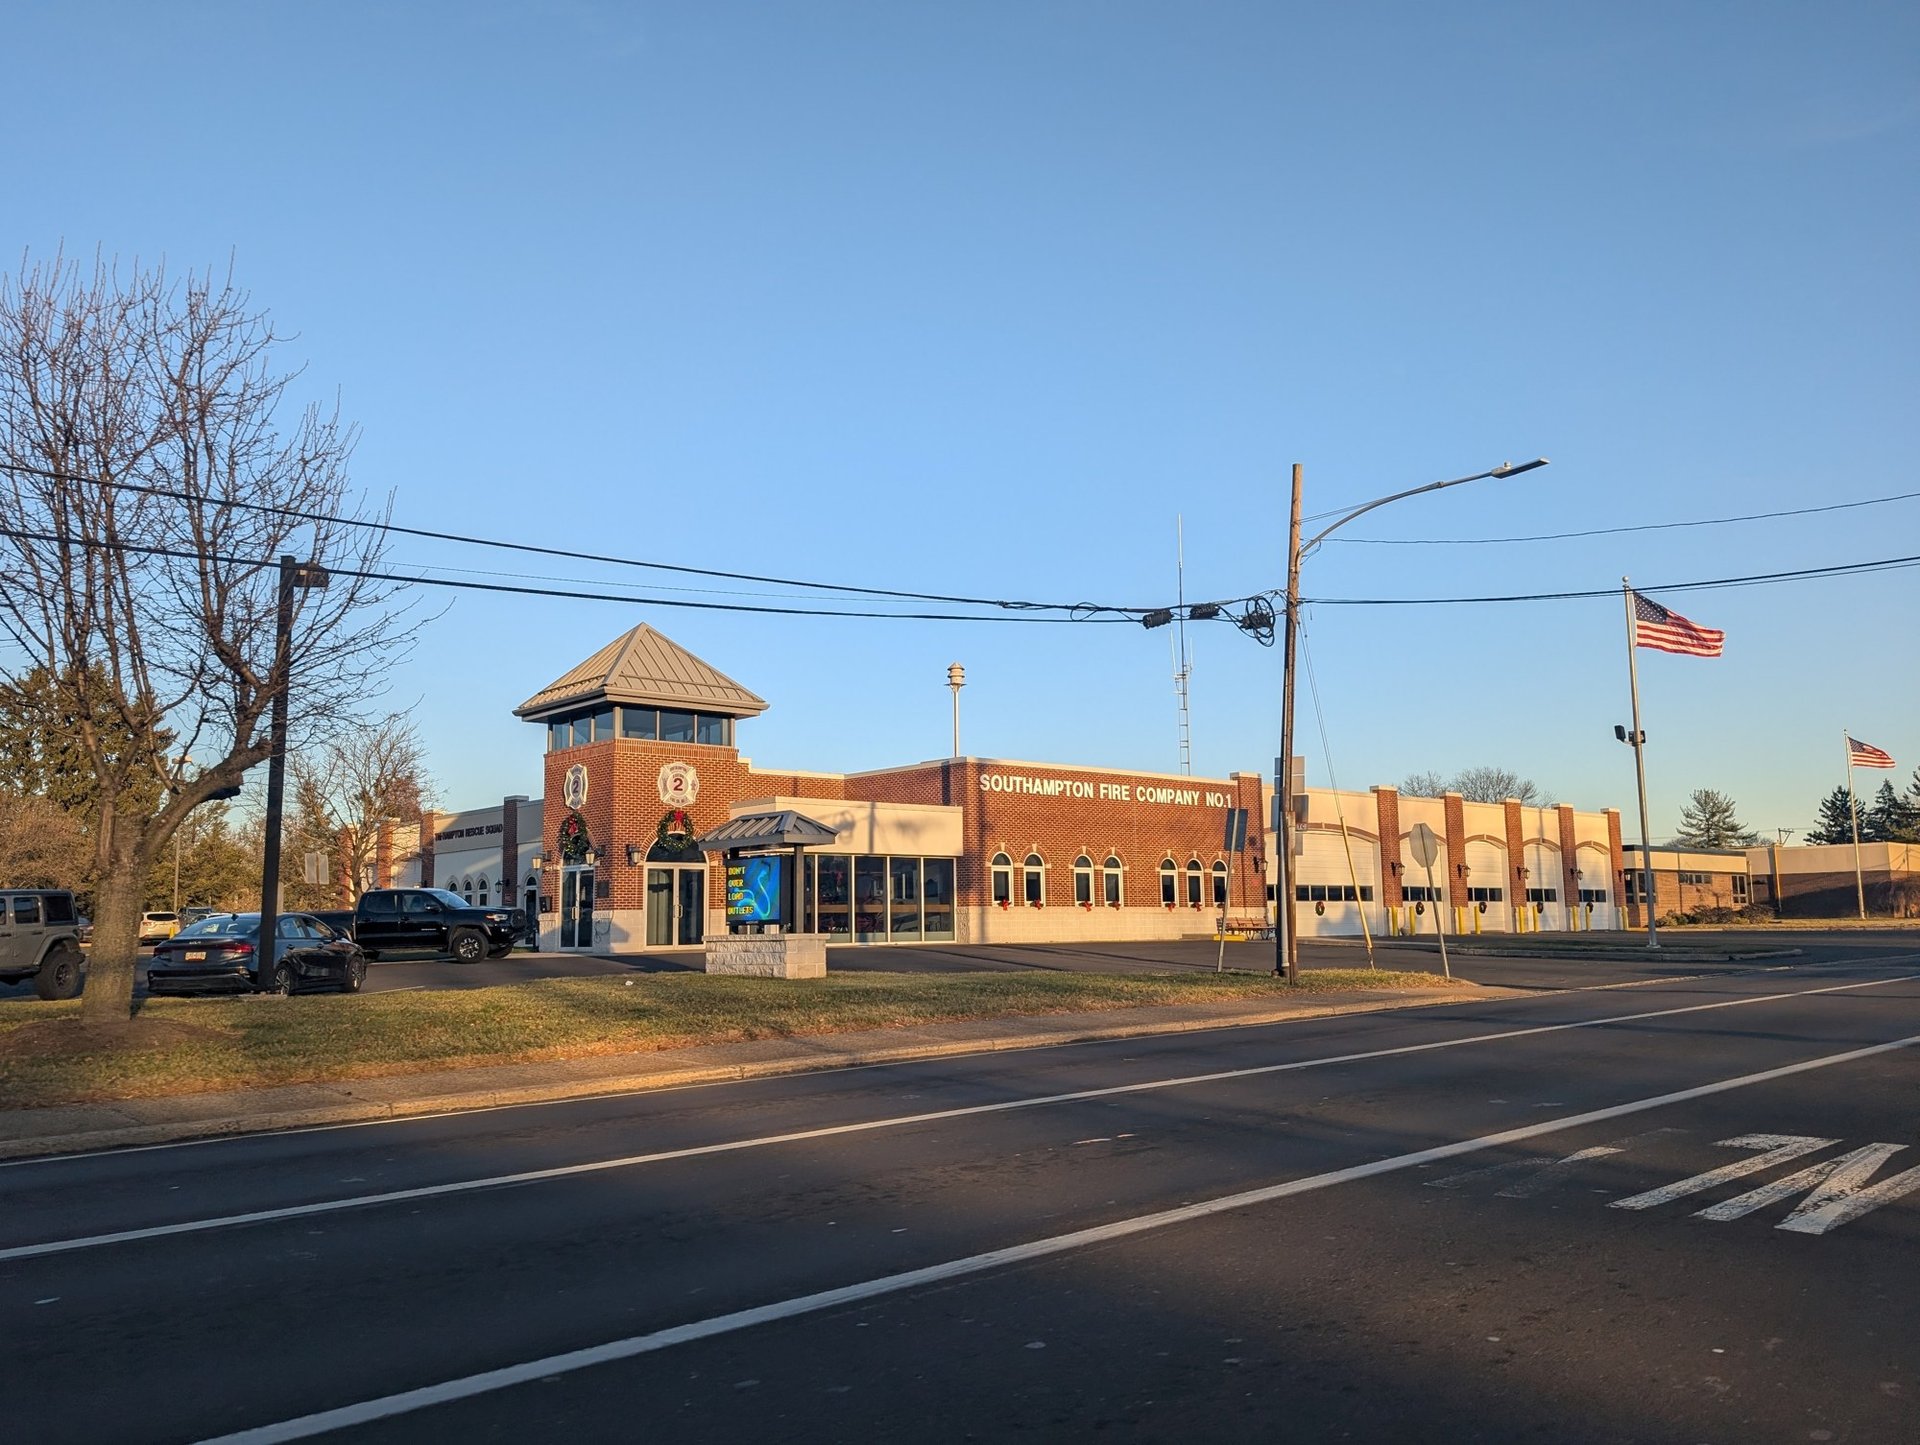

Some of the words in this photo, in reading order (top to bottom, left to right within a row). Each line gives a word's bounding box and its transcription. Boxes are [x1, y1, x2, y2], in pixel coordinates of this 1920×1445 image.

[573, 780, 579, 793] 2
[673, 778, 683, 791] 2
[980, 774, 1094, 798] SOUTHAMPTON
[1099, 783, 1131, 801] FIRE
[1136, 786, 1200, 806] COMPANY
[465, 826, 485, 837] RESCUE
[485, 823, 503, 834] SQUAD
[728, 866, 746, 875] DON'T
[728, 879, 744, 887] OVER
[728, 892, 744, 901] LOAD
[727, 906, 754, 915] OUTLETS
